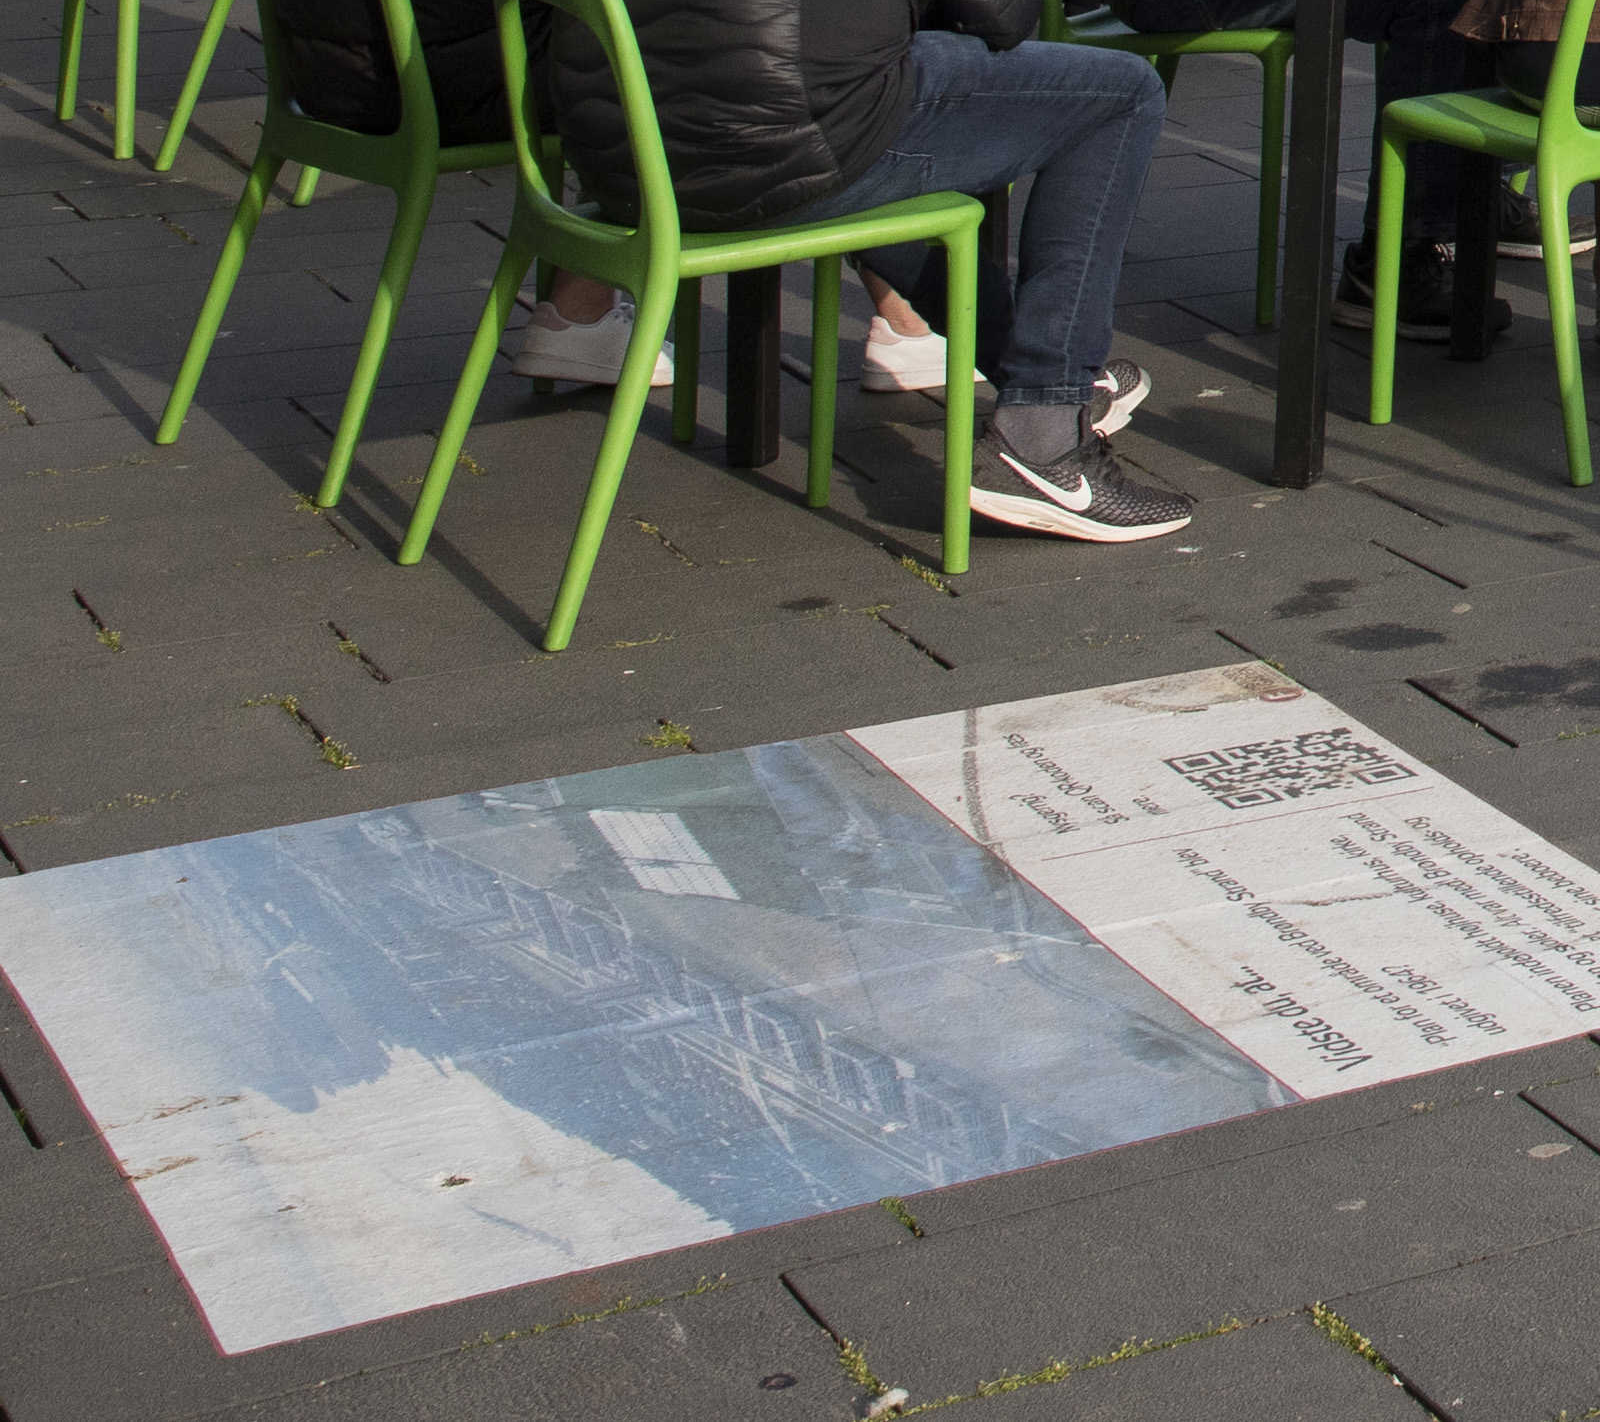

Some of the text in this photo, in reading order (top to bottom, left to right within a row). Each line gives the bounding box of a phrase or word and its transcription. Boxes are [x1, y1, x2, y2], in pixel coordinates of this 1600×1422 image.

[1033, 758, 1092, 796] QR-koden
[1081, 795, 1115, 814] scan
[1338, 813, 1397, 842] Strand
[1173, 849, 1209, 867] blev
[1388, 841, 1451, 879] Brøndby
[1424, 830, 1484, 865] opholds-
[1363, 857, 1432, 903] kulturhus,
[1435, 878, 1486, 900] med!
[1244, 902, 1309, 941] Brøndby
[1426, 901, 1488, 939] højhuse,
[1476, 937, 1555, 978] indeholdt
[1521, 927, 1575, 953] skoler.
[1320, 957, 1384, 993] område
[1381, 965, 1442, 994] 1964?
[1440, 998, 1507, 1035] udgivet
[1293, 1017, 1373, 1072] Vidste
